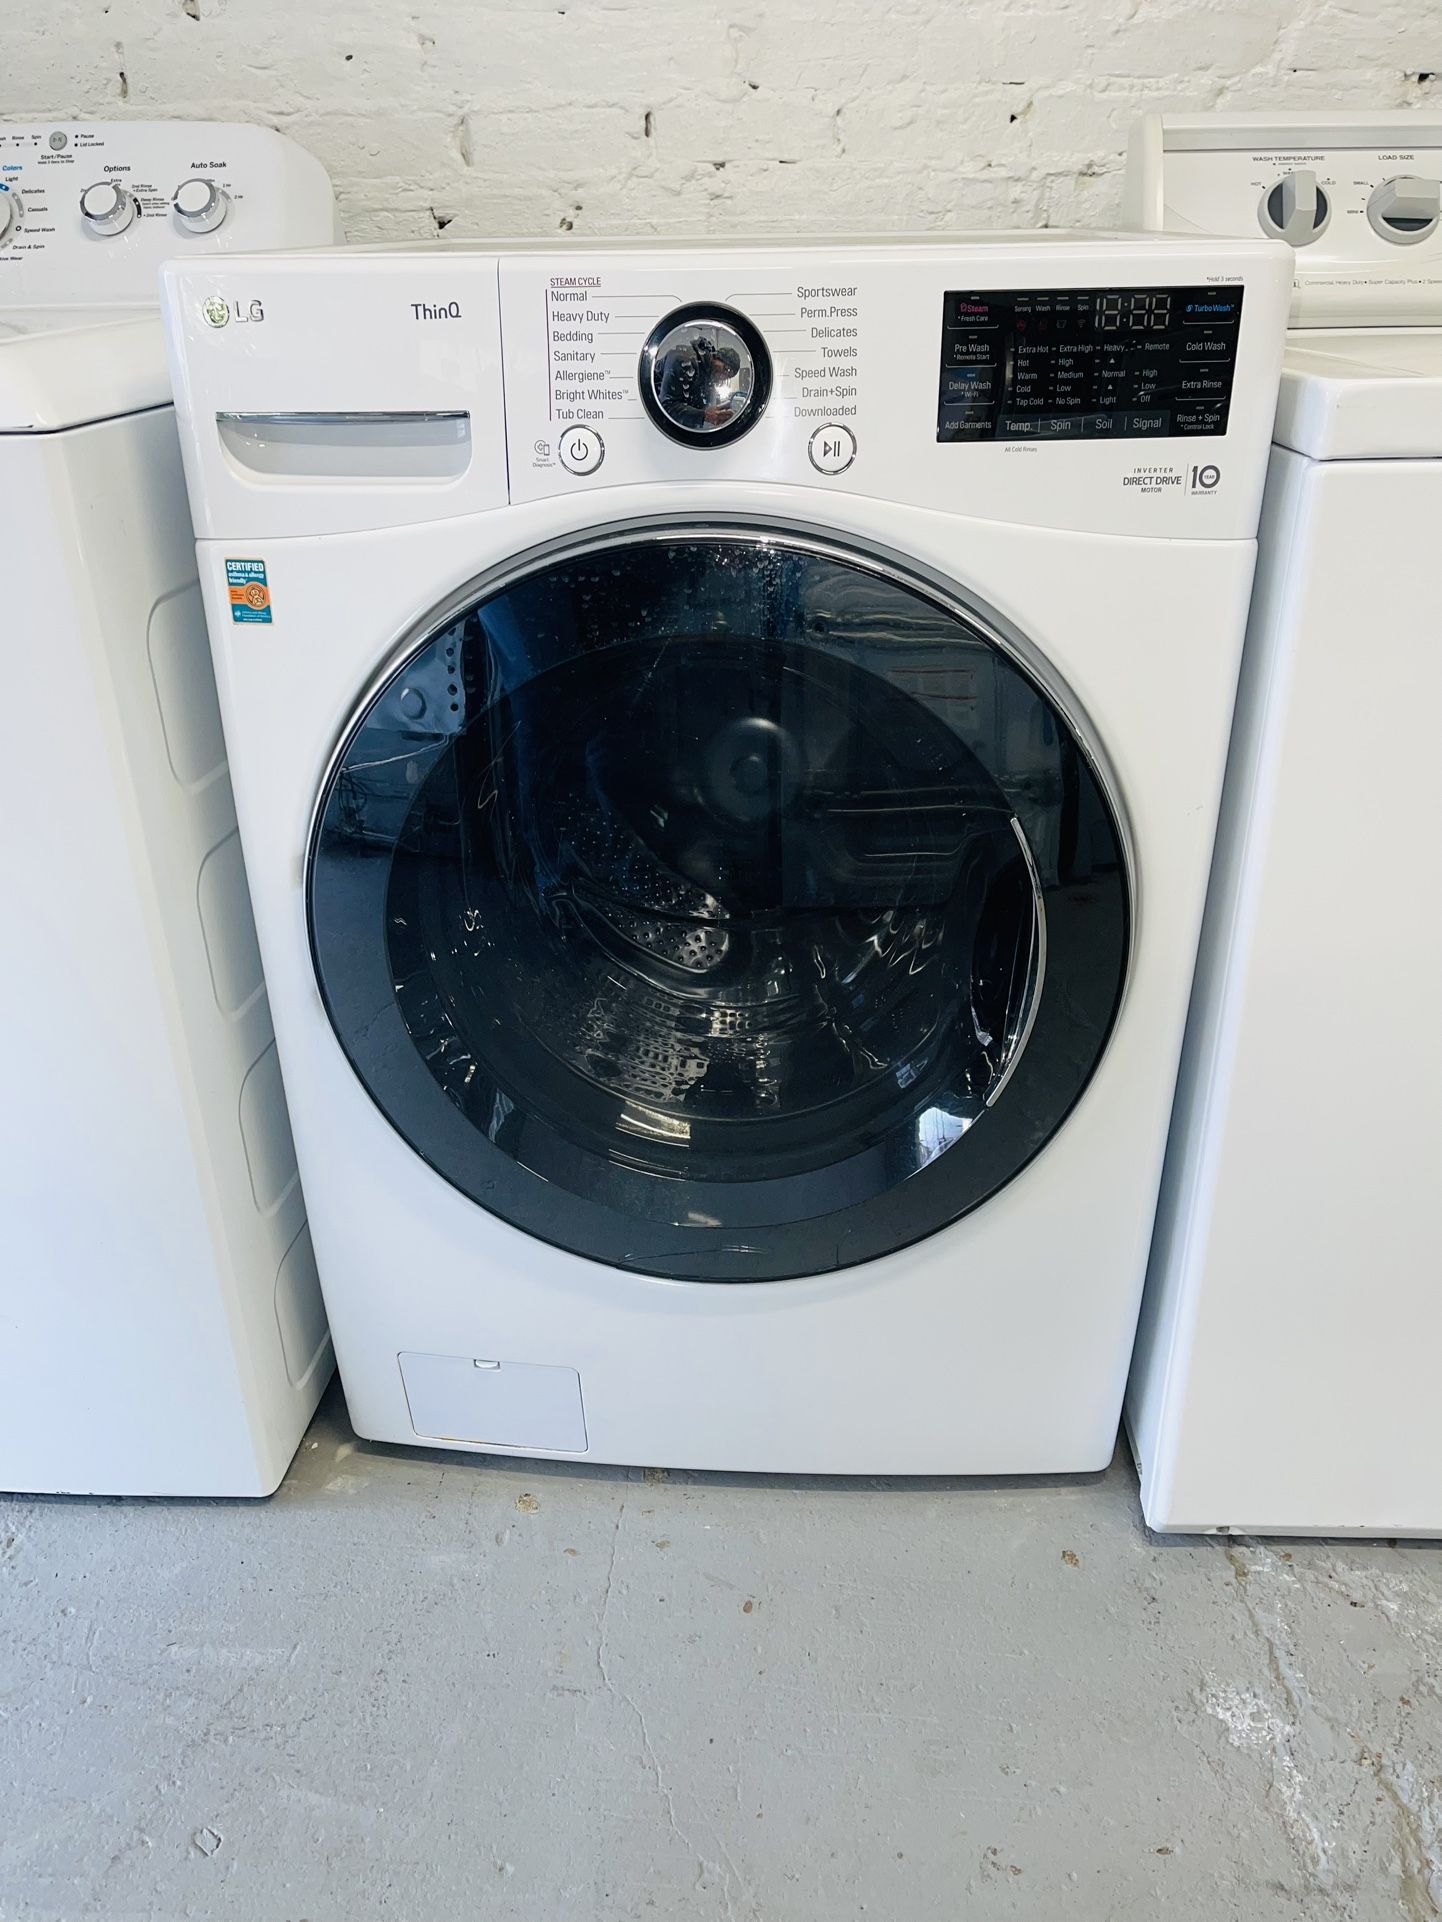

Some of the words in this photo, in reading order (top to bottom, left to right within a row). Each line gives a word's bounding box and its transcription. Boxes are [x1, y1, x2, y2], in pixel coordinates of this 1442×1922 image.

[550, 278, 576, 287] STEAM
[577, 277, 601, 286] CYCLE
[551, 290, 588, 302] Normal
[797, 285, 857, 300] Sportswear
[234, 300, 264, 323] LG
[410, 301, 462, 321] ThinQ
[800, 306, 858, 320] Perm.Press
[968, 304, 989, 312] Steam
[552, 311, 586, 323] Heavy
[588, 311, 610, 323] Duty
[553, 330, 594, 344] Bedding
[811, 327, 858, 339] Delicates
[955, 344, 967, 352] Pre
[968, 343, 990, 352] Wash
[1059, 345, 1077, 353] Extra
[1078, 344, 1093, 354] High
[1104, 343, 1125, 352] Heavy
[1145, 342, 1170, 350] Remote
[1186, 342, 1203, 351] Cold
[1204, 342, 1226, 350] Wash
[554, 350, 596, 364] Sanitary
[821, 346, 858, 358] Towels
[1018, 359, 1030, 367] Hot
[1058, 358, 1074, 367] High
[794, 367, 826, 380] Speed
[827, 366, 857, 378] Wash
[1018, 372, 1038, 380] Warm
[1058, 371, 1084, 379] Medium
[1102, 370, 1126, 378] Normal
[1142, 369, 1158, 378] High
[949, 382, 969, 391] Delay
[970, 381, 991, 390] Wash
[1182, 380, 1201, 389] Extra
[1202, 380, 1222, 388] Rinse
[555, 389, 586, 403] Bright
[802, 386, 857, 400] Drain+Spin
[1016, 398, 1029, 407] Tap
[1030, 397, 1044, 405] Cold
[1066, 397, 1081, 405] Spin
[1100, 396, 1116, 405] Light
[1140, 395, 1151, 403] Off
[556, 408, 575, 420] Tub
[576, 408, 604, 420] Clean
[794, 405, 857, 417] Downloaded
[1177, 414, 1196, 422] Rinse
[1204, 414, 1220, 422] Spin
[945, 421, 959, 429] Add
[960, 420, 992, 429] Garments
[1005, 420, 1033, 433] Temp.
[1050, 420, 1071, 432] Spin
[1095, 418, 1113, 430] Soil
[1133, 418, 1162, 430] Signal
[1122, 476, 1154, 486] DIRECT
[1155, 475, 1182, 485] DRIVE
[1191, 464, 1221, 489] 10
[227, 561, 264, 572] CERTIFIED
